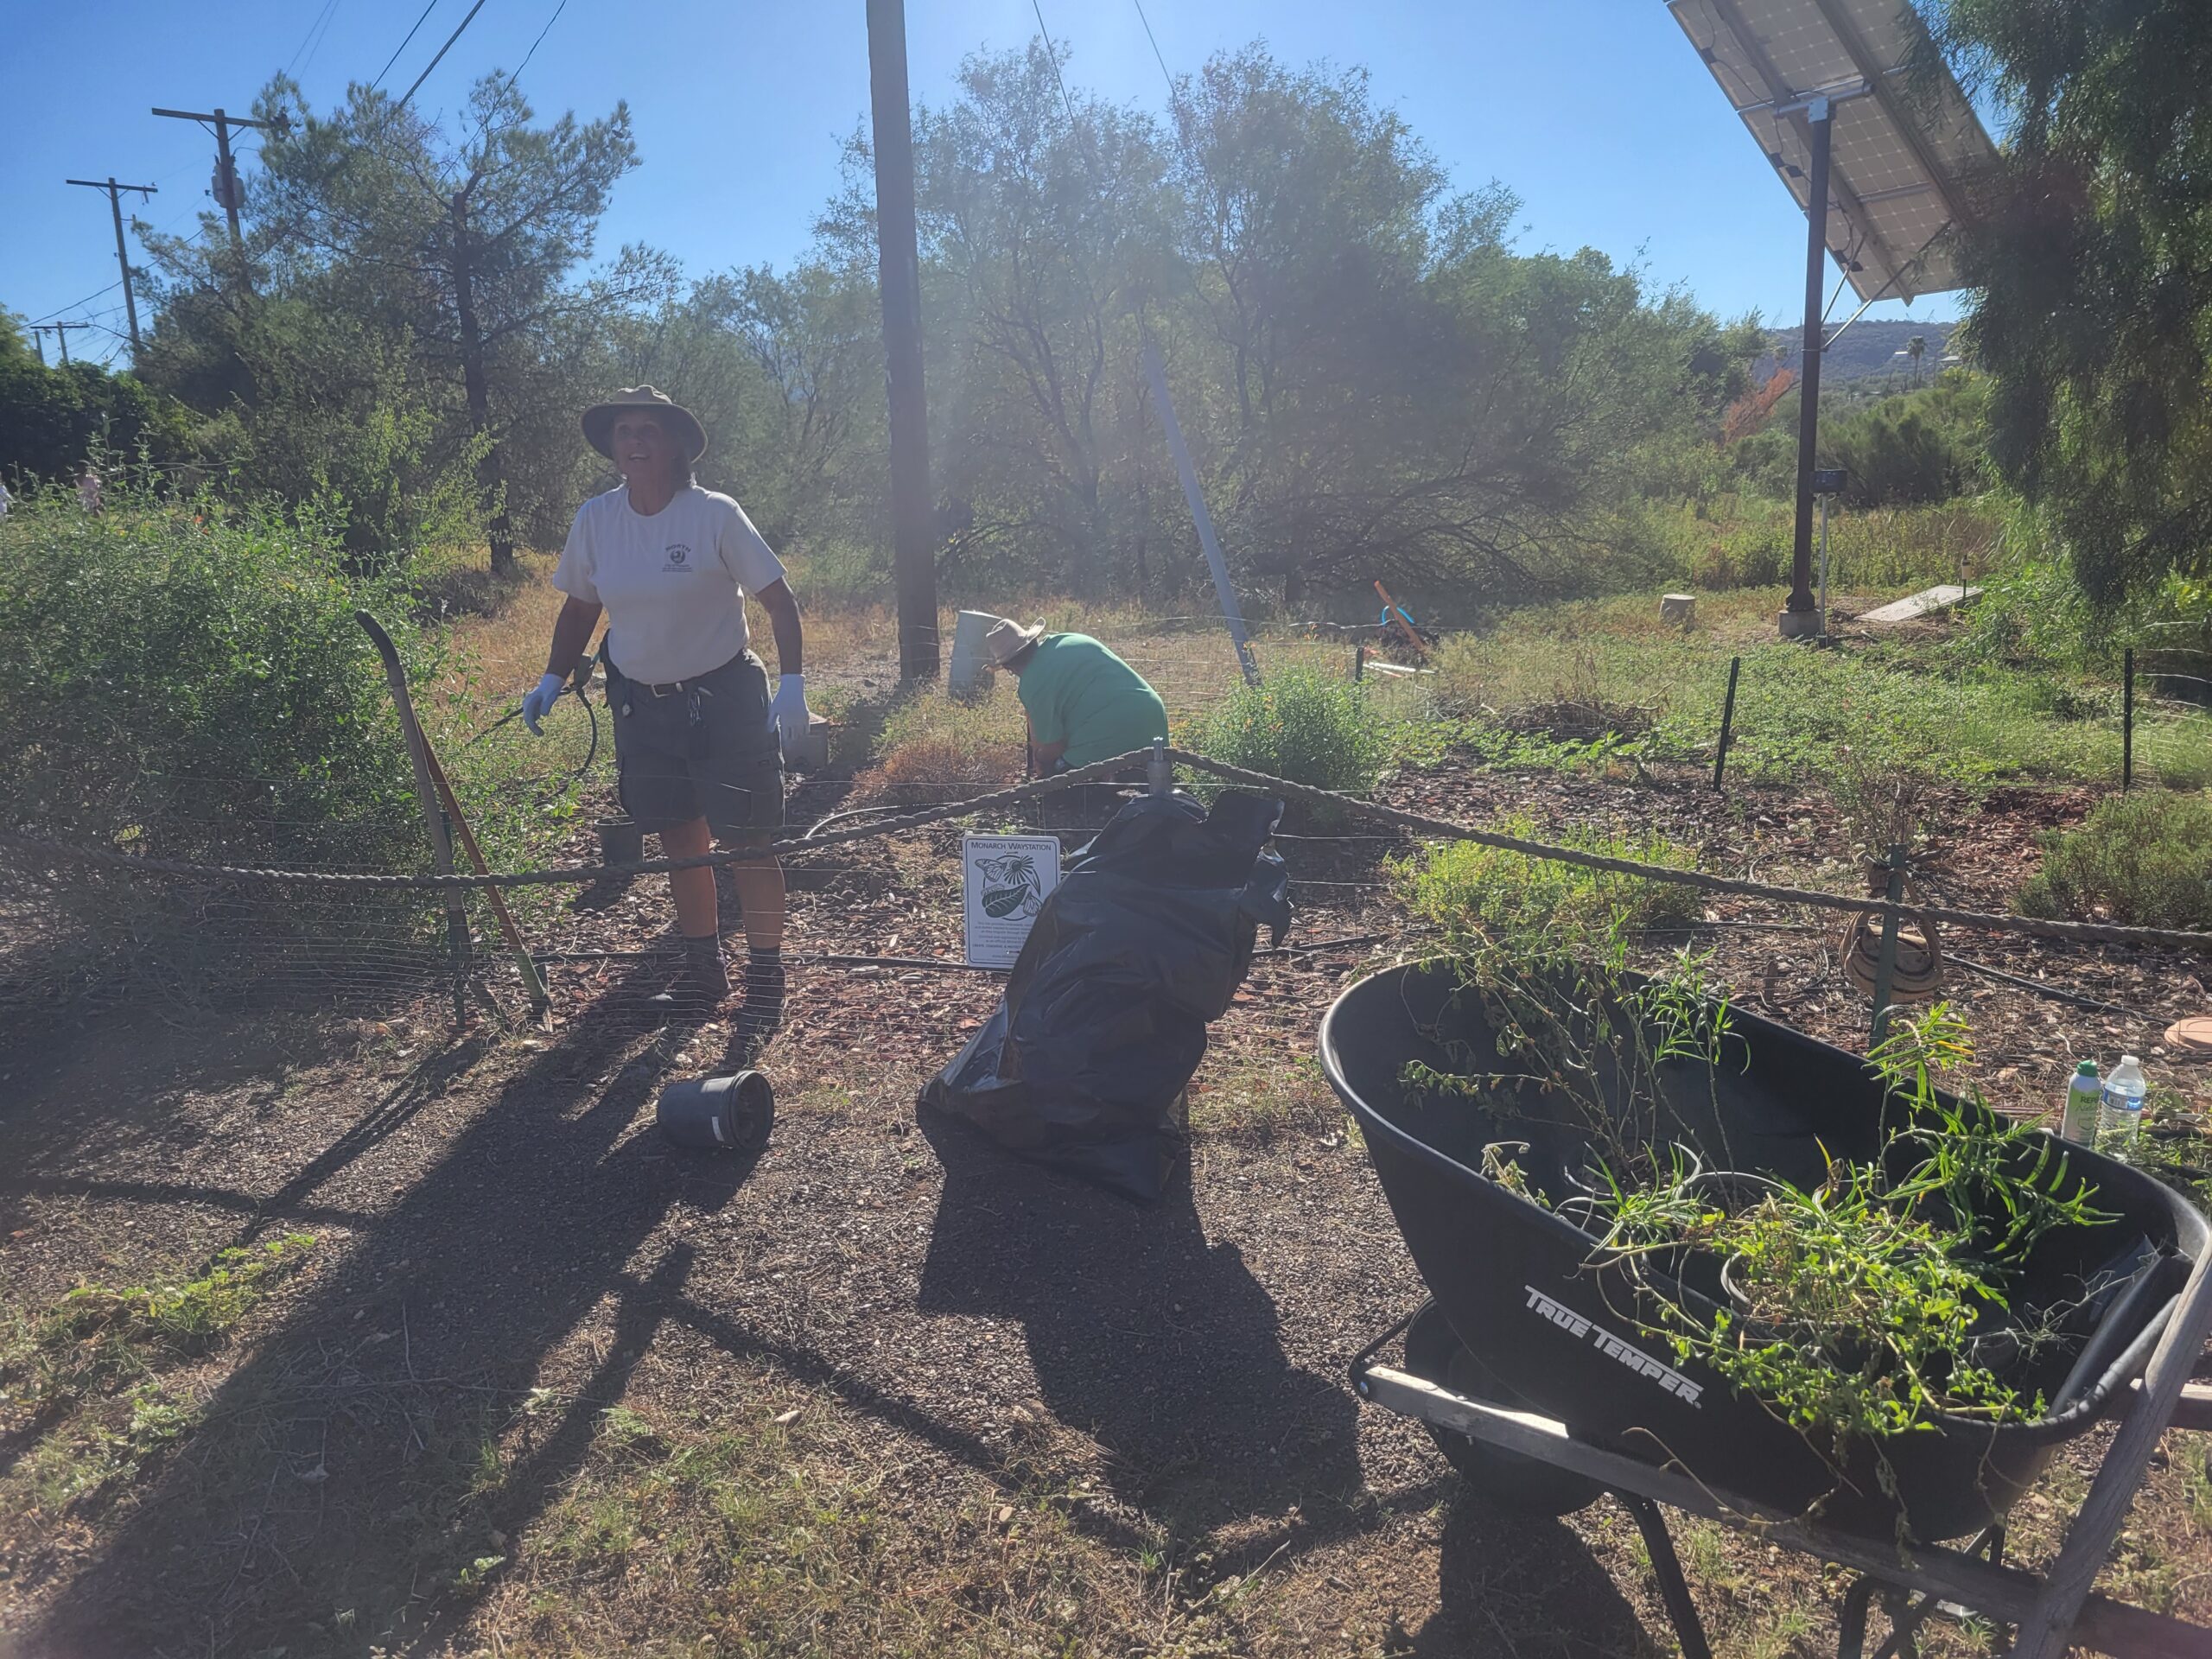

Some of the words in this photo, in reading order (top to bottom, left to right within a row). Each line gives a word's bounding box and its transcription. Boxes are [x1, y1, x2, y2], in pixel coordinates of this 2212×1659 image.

[665, 543, 692, 553] NORTH
[970, 842, 1007, 850] MONARCH
[1007, 842, 1052, 851] WAYSTATION
[1524, 1284, 1593, 1338] TRUE
[1592, 1323, 1705, 1407] TEMPER
